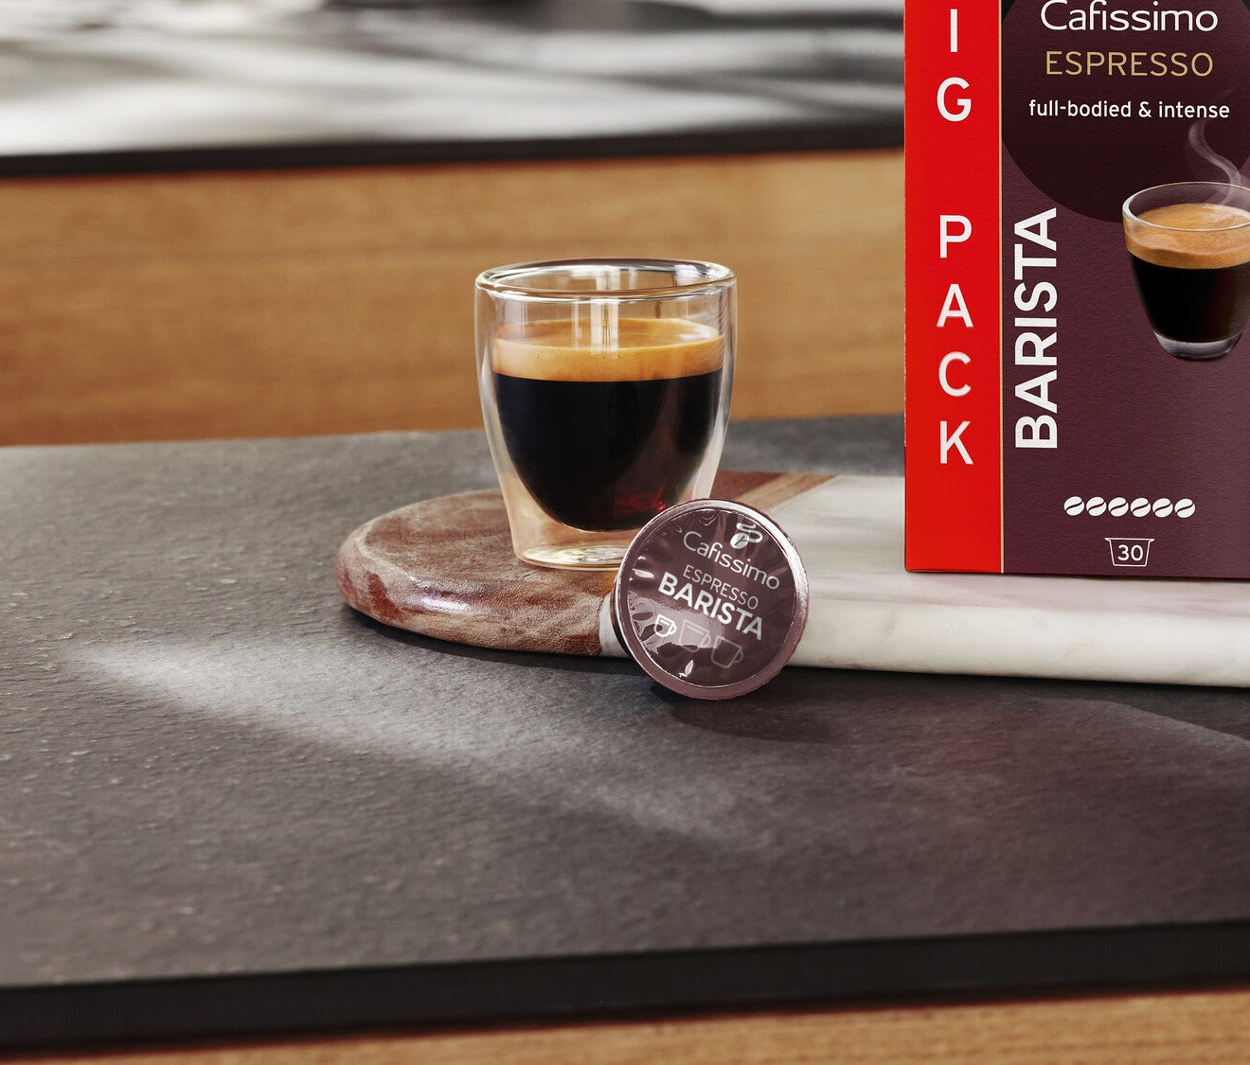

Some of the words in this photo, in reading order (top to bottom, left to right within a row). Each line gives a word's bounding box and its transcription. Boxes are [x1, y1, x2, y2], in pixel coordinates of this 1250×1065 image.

[1045, 50, 1214, 77] ESPRESSO
[1028, 99, 1132, 118] full-bodied
[1138, 100, 1152, 118] &
[1158, 100, 1230, 119] intense
[936, 214, 974, 465] PACK
[1014, 207, 1058, 449] BARISTA
[683, 531, 780, 590] Cafissimo
[1117, 544, 1144, 562] 30
[657, 572, 763, 641] BARISTA
[683, 564, 759, 610] ESPRESSO
